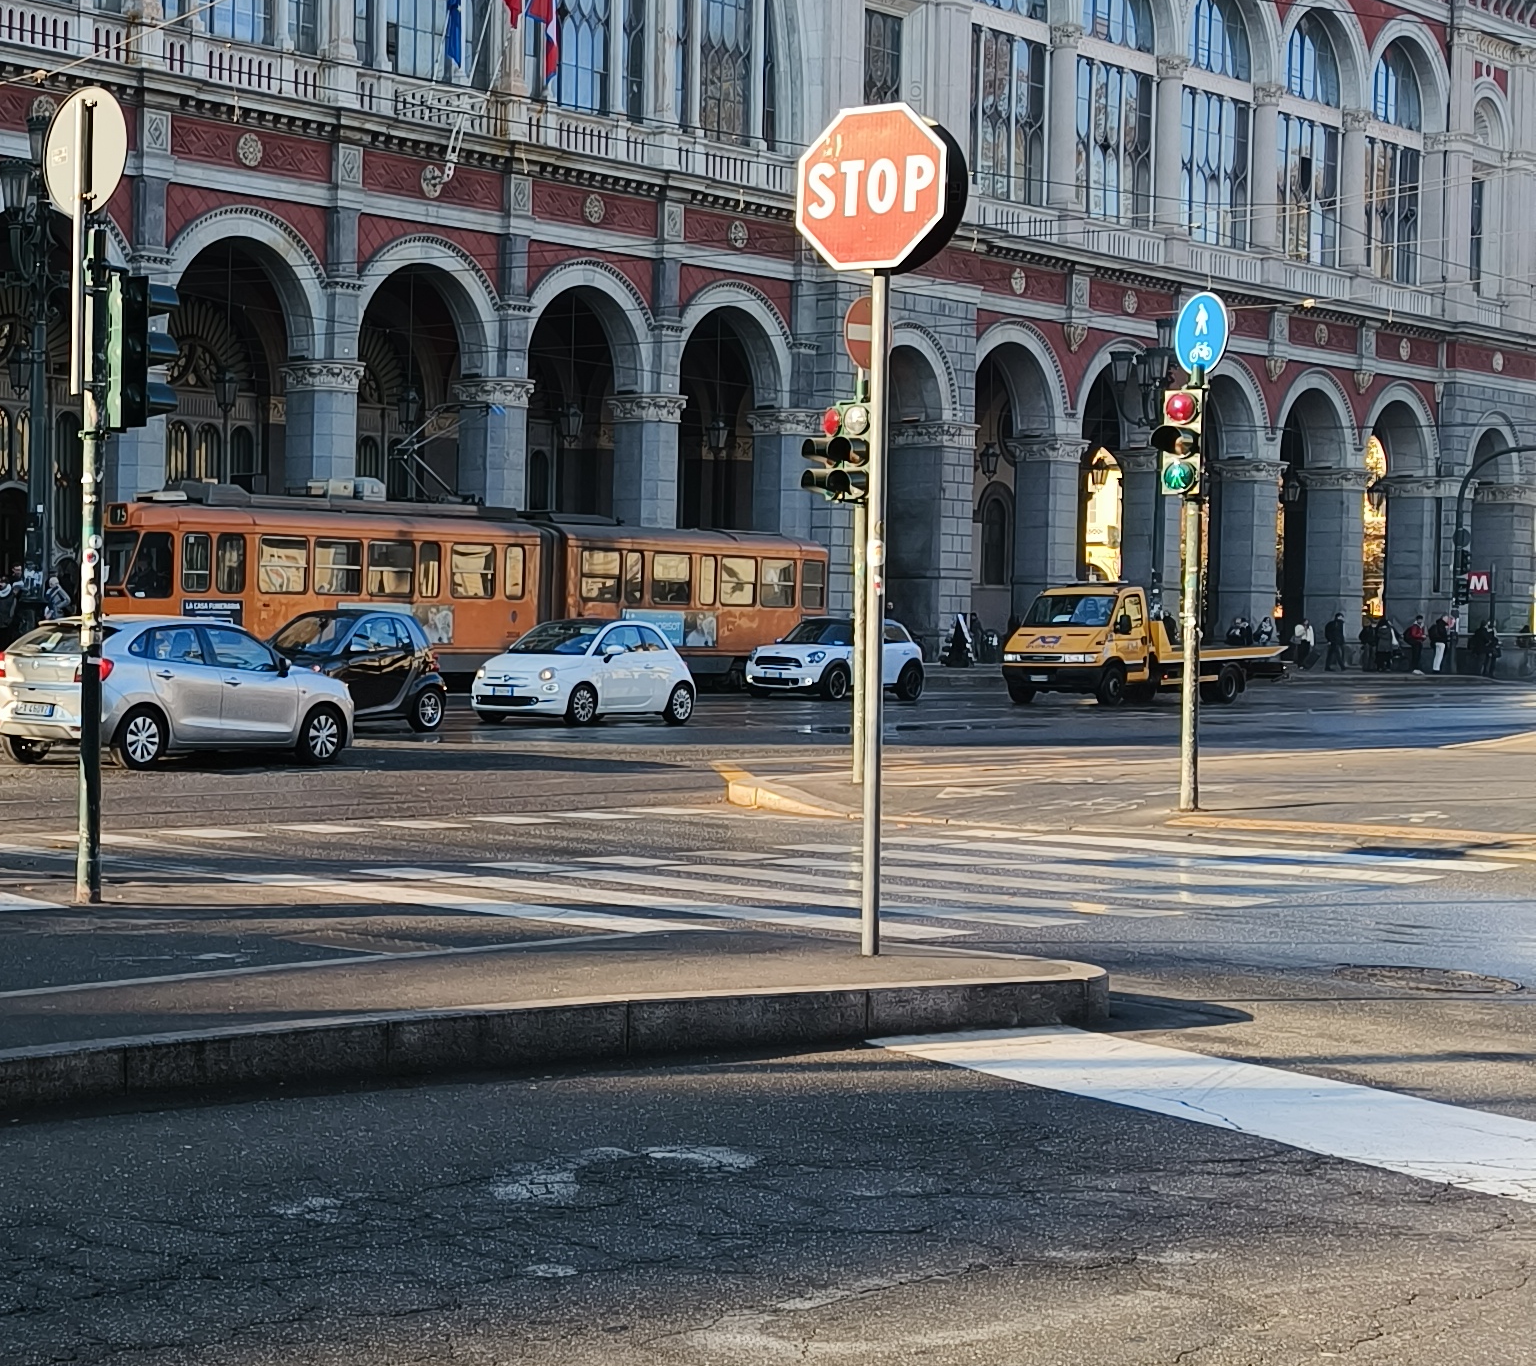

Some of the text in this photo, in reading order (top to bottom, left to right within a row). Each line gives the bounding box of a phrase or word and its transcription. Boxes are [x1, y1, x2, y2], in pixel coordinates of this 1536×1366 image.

[806, 154, 936, 220] STOP
[117, 508, 127, 522] 15
[1469, 575, 1488, 590] M
